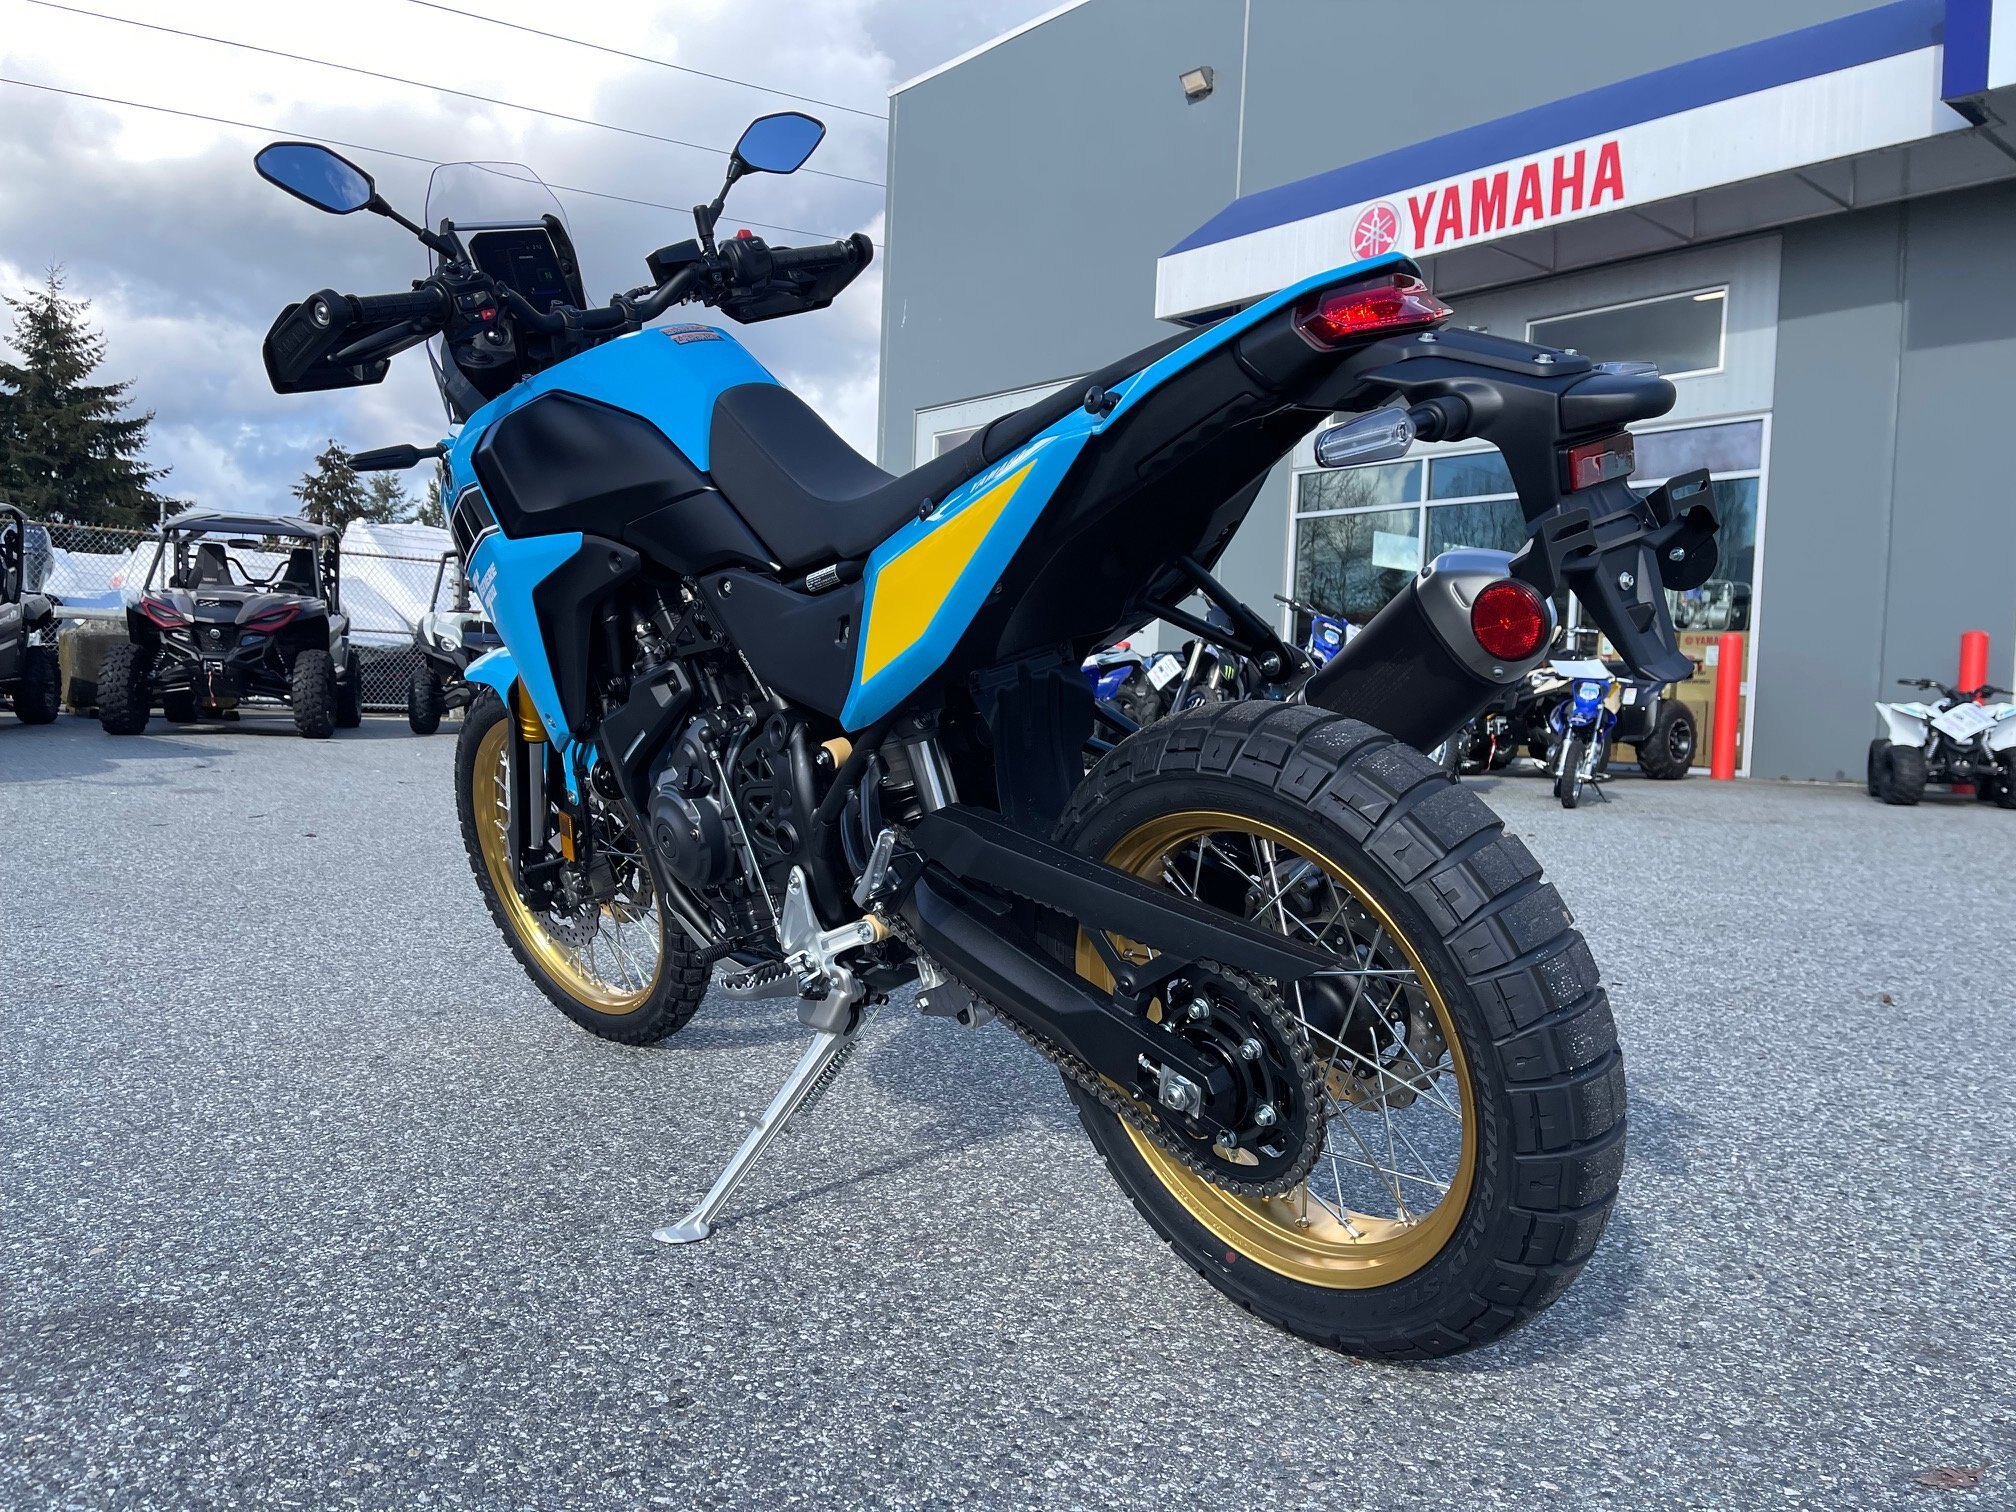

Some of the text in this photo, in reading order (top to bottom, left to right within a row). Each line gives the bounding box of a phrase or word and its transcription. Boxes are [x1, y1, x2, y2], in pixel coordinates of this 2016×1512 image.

[1408, 140, 1624, 250] YAMAHA
[1696, 636, 1719, 646] YAMA
[1423, 944, 1499, 1177] SCORPION
[1448, 1177, 1495, 1282] RALLY
